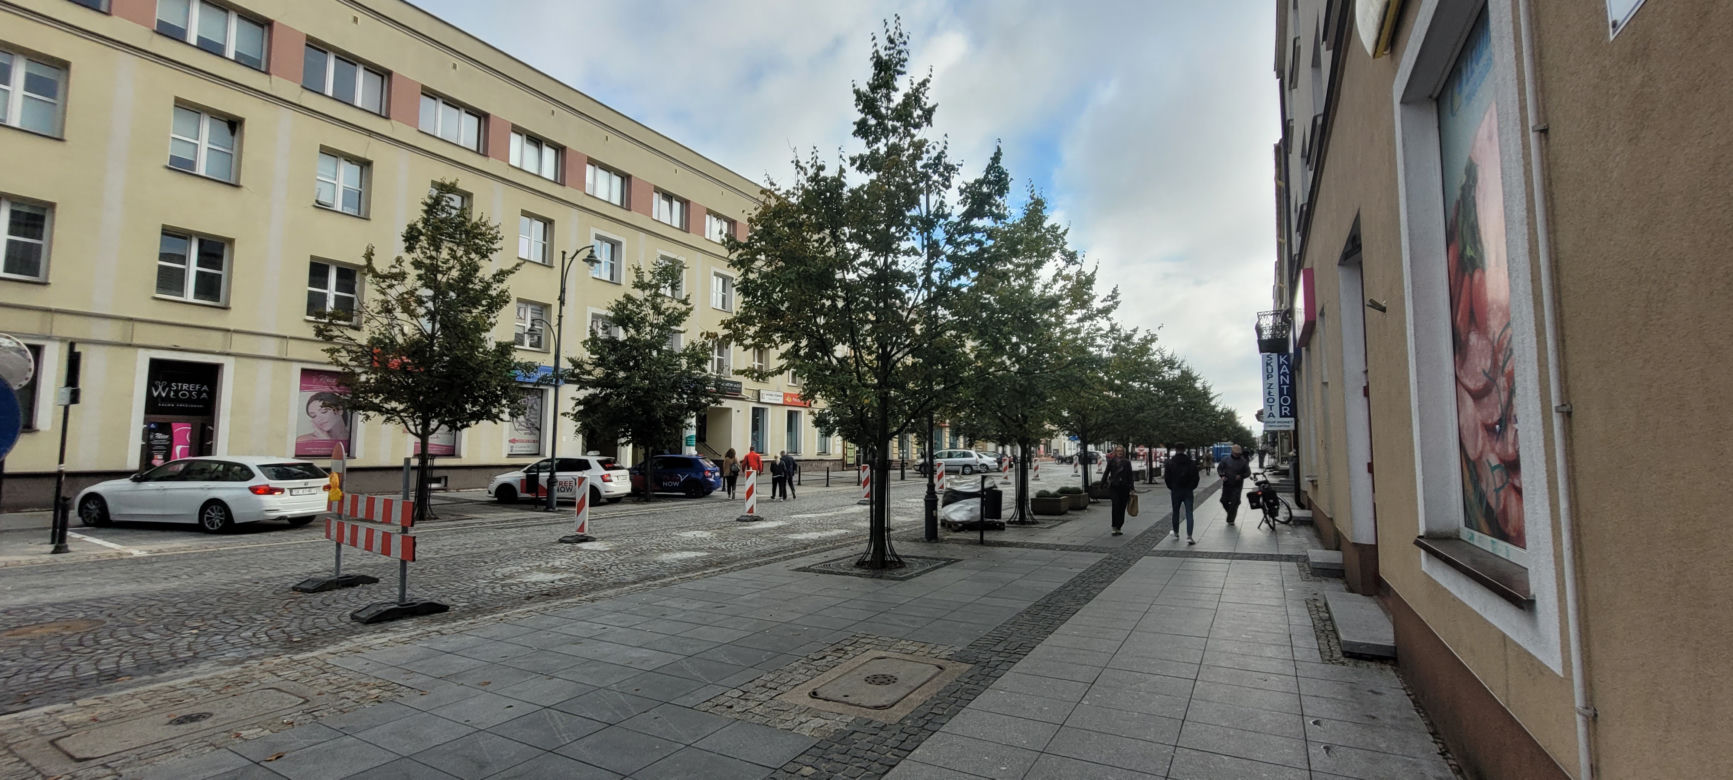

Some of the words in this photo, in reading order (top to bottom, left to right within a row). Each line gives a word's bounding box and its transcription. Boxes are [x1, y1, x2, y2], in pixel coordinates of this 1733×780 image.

[1265, 354, 1273, 380] SKUP
[171, 383, 209, 391] STREFA
[1266, 383, 1275, 418] ZŁOTA
[1280, 355, 1291, 416] KANTOR
